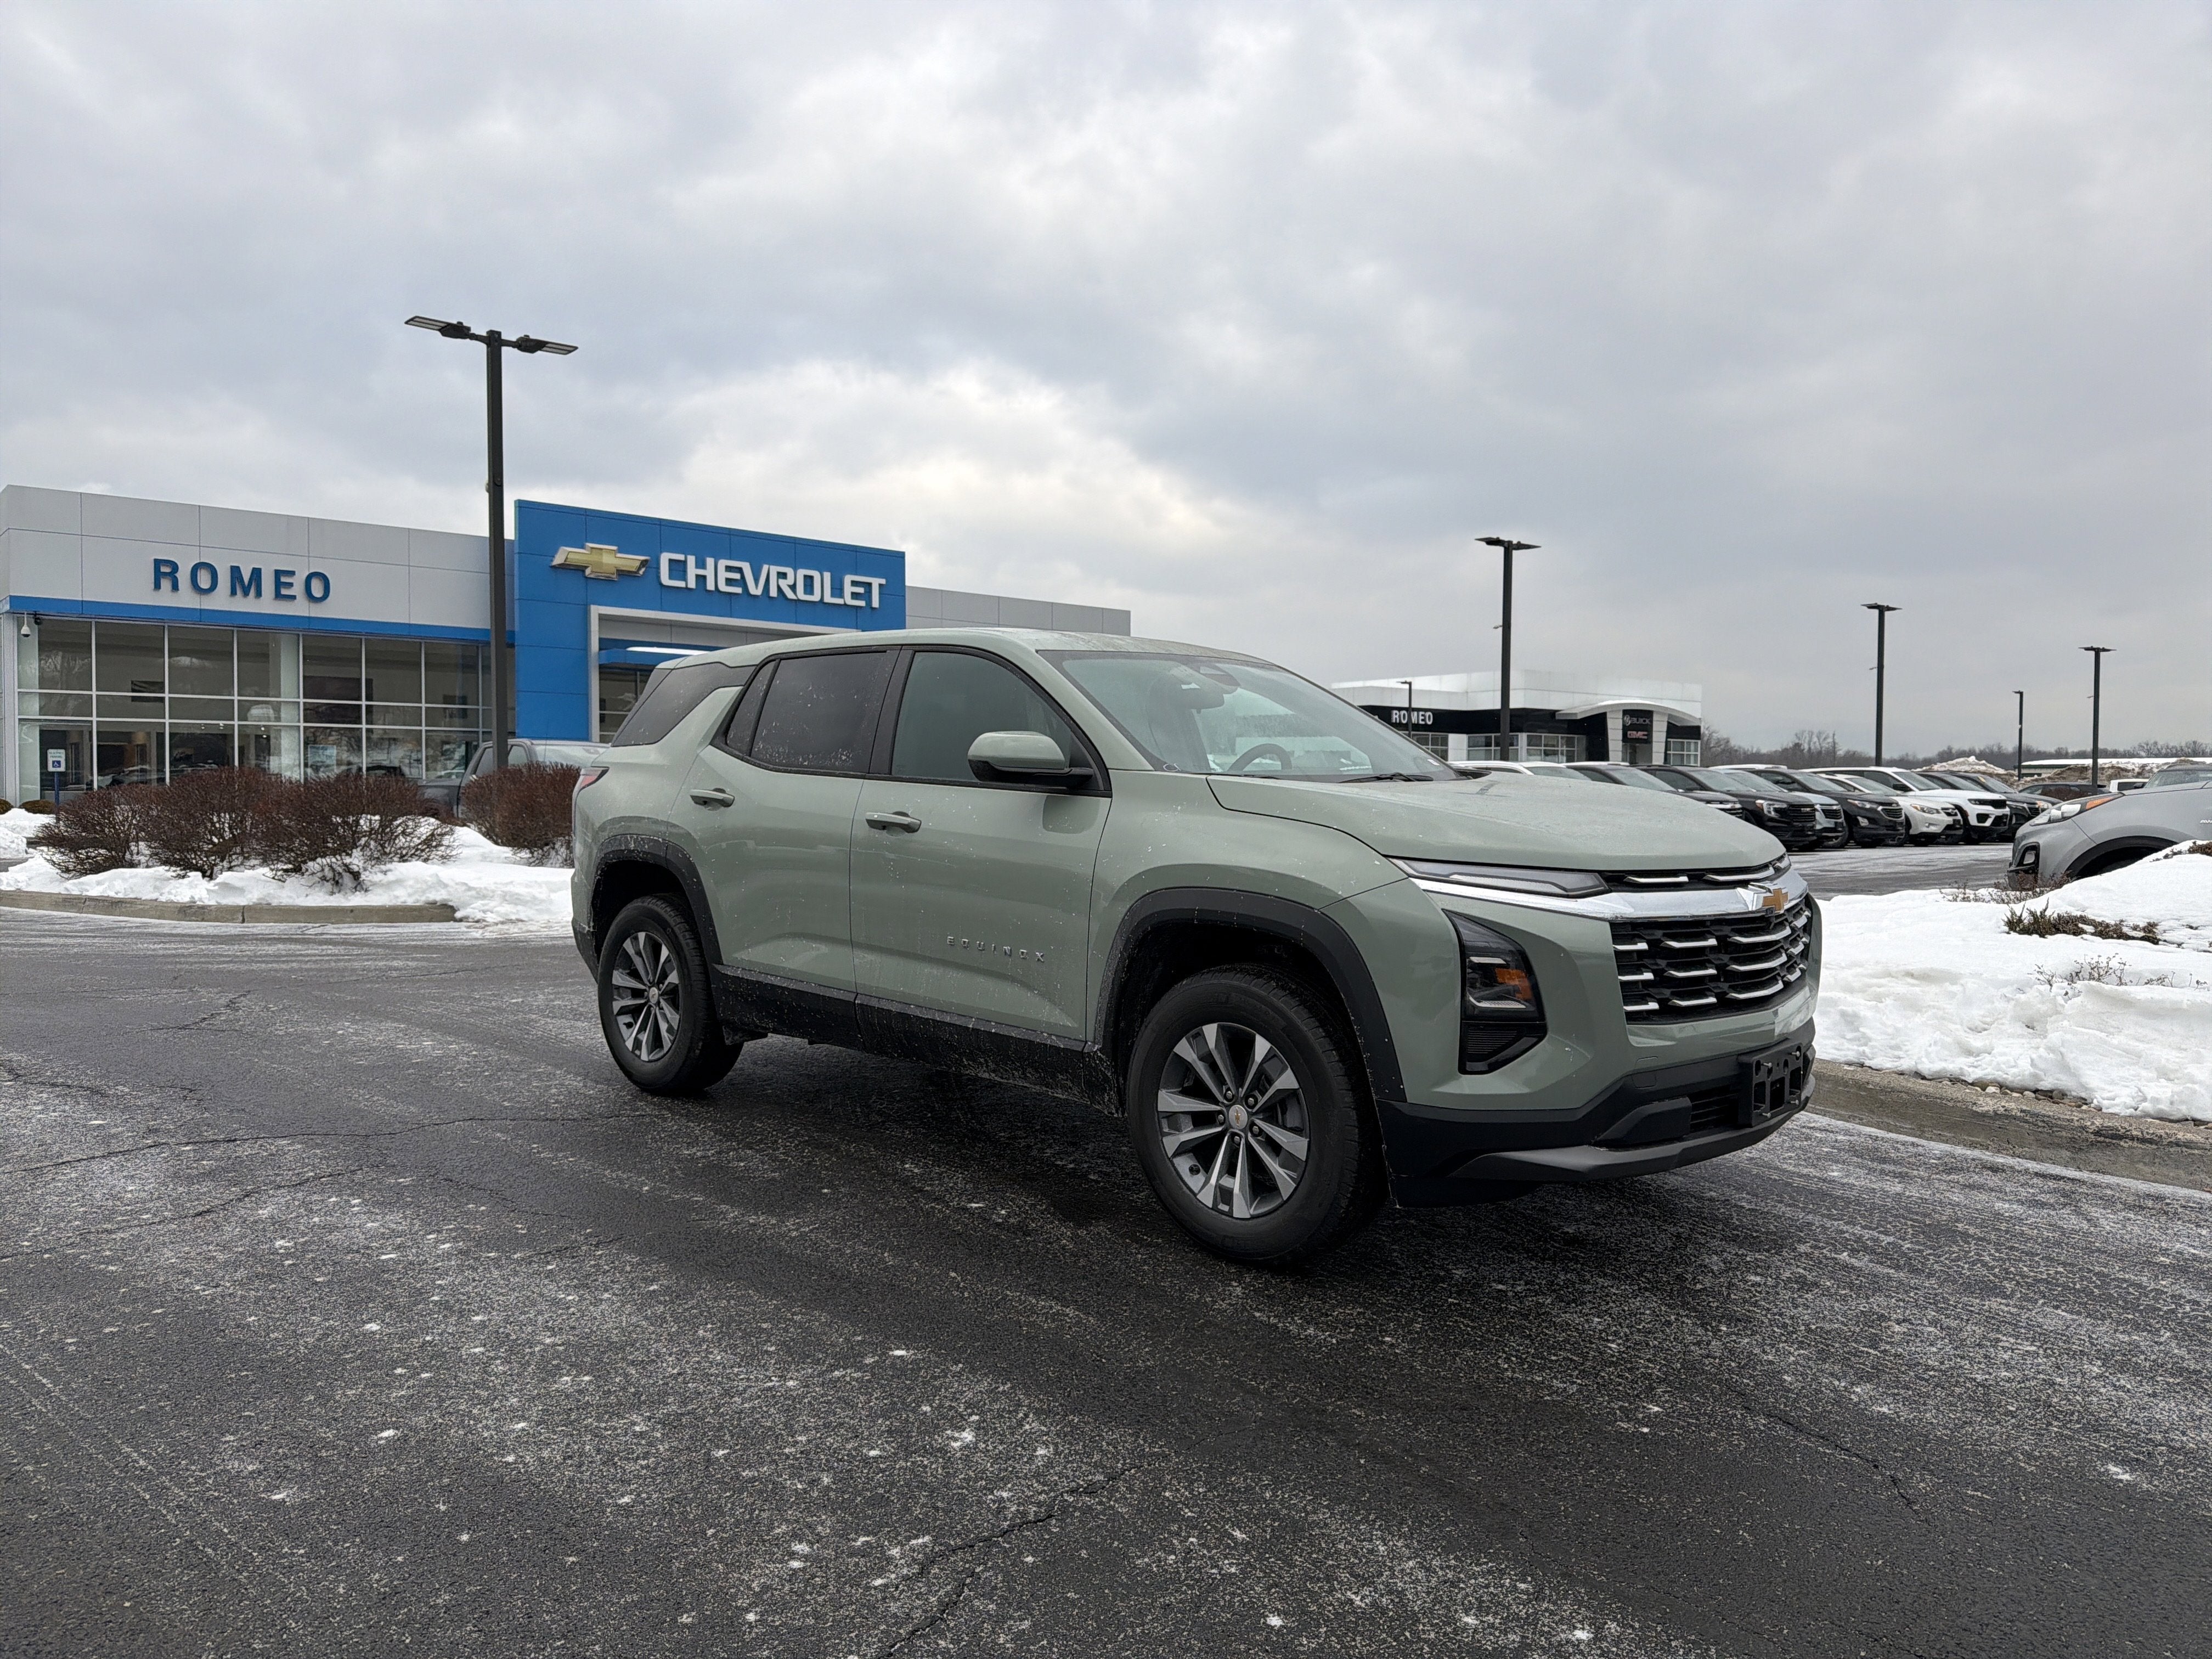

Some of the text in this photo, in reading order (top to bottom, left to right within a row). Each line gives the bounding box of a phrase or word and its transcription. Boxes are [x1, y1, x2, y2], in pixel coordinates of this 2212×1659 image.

[153, 558, 331, 603] ROMEO
[660, 552, 886, 608] CHEVROLET
[1391, 710, 1433, 725] ROMEO
[1627, 731, 1648, 739] GMC
[947, 936, 1045, 963] EQUINOX
